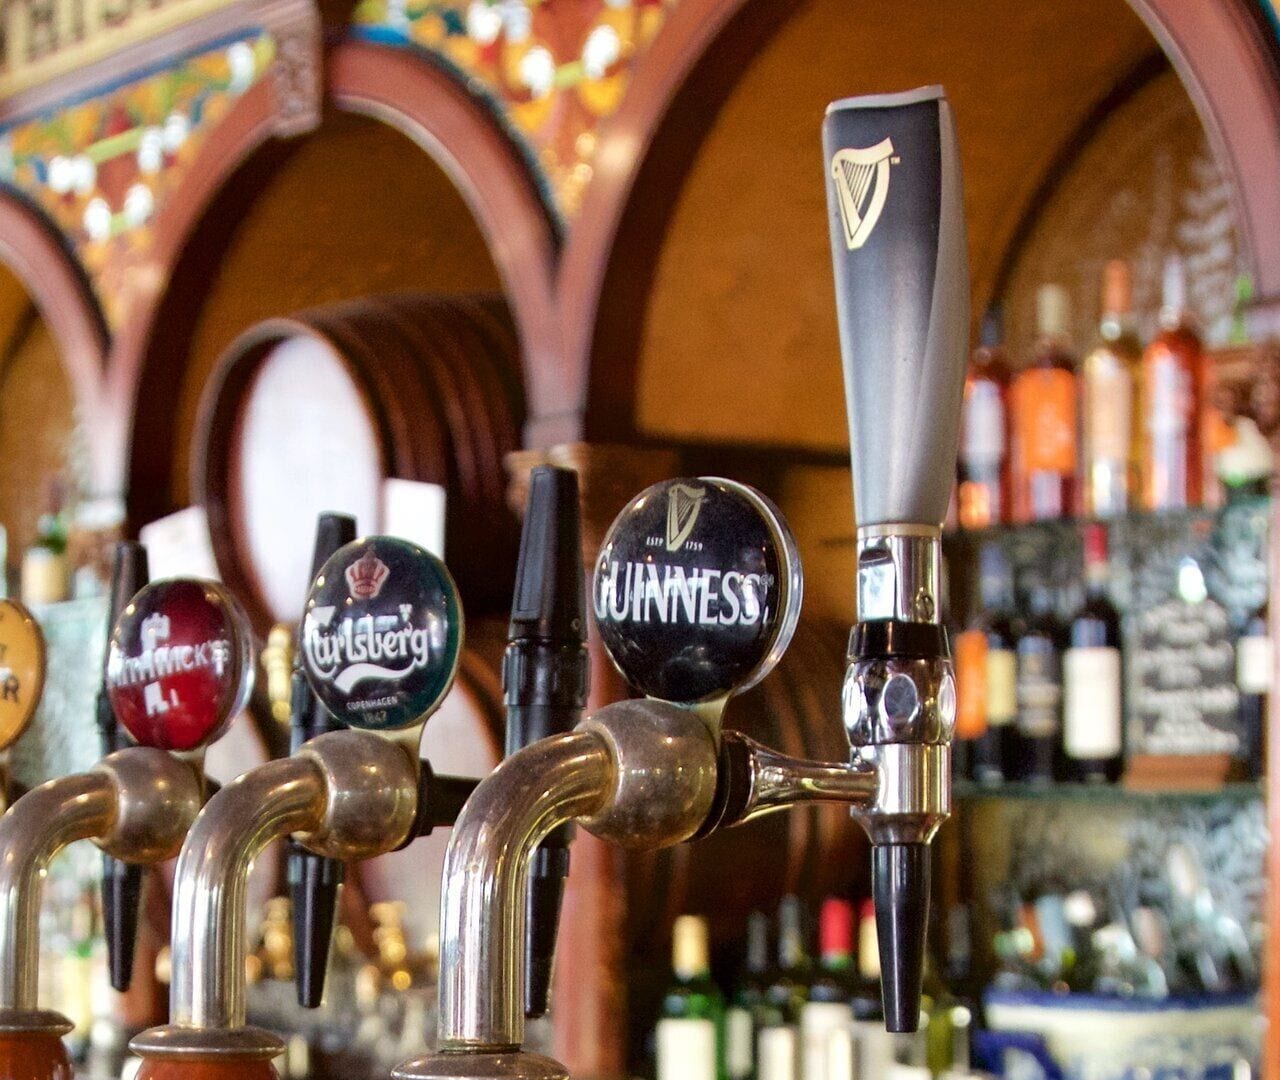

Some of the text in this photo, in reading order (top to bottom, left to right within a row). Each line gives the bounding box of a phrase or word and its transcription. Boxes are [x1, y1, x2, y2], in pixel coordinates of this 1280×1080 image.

[685, 541, 703, 551] 1759
[305, 604, 428, 688] Carlsberg
[346, 696, 398, 710] COPENHAGEN
